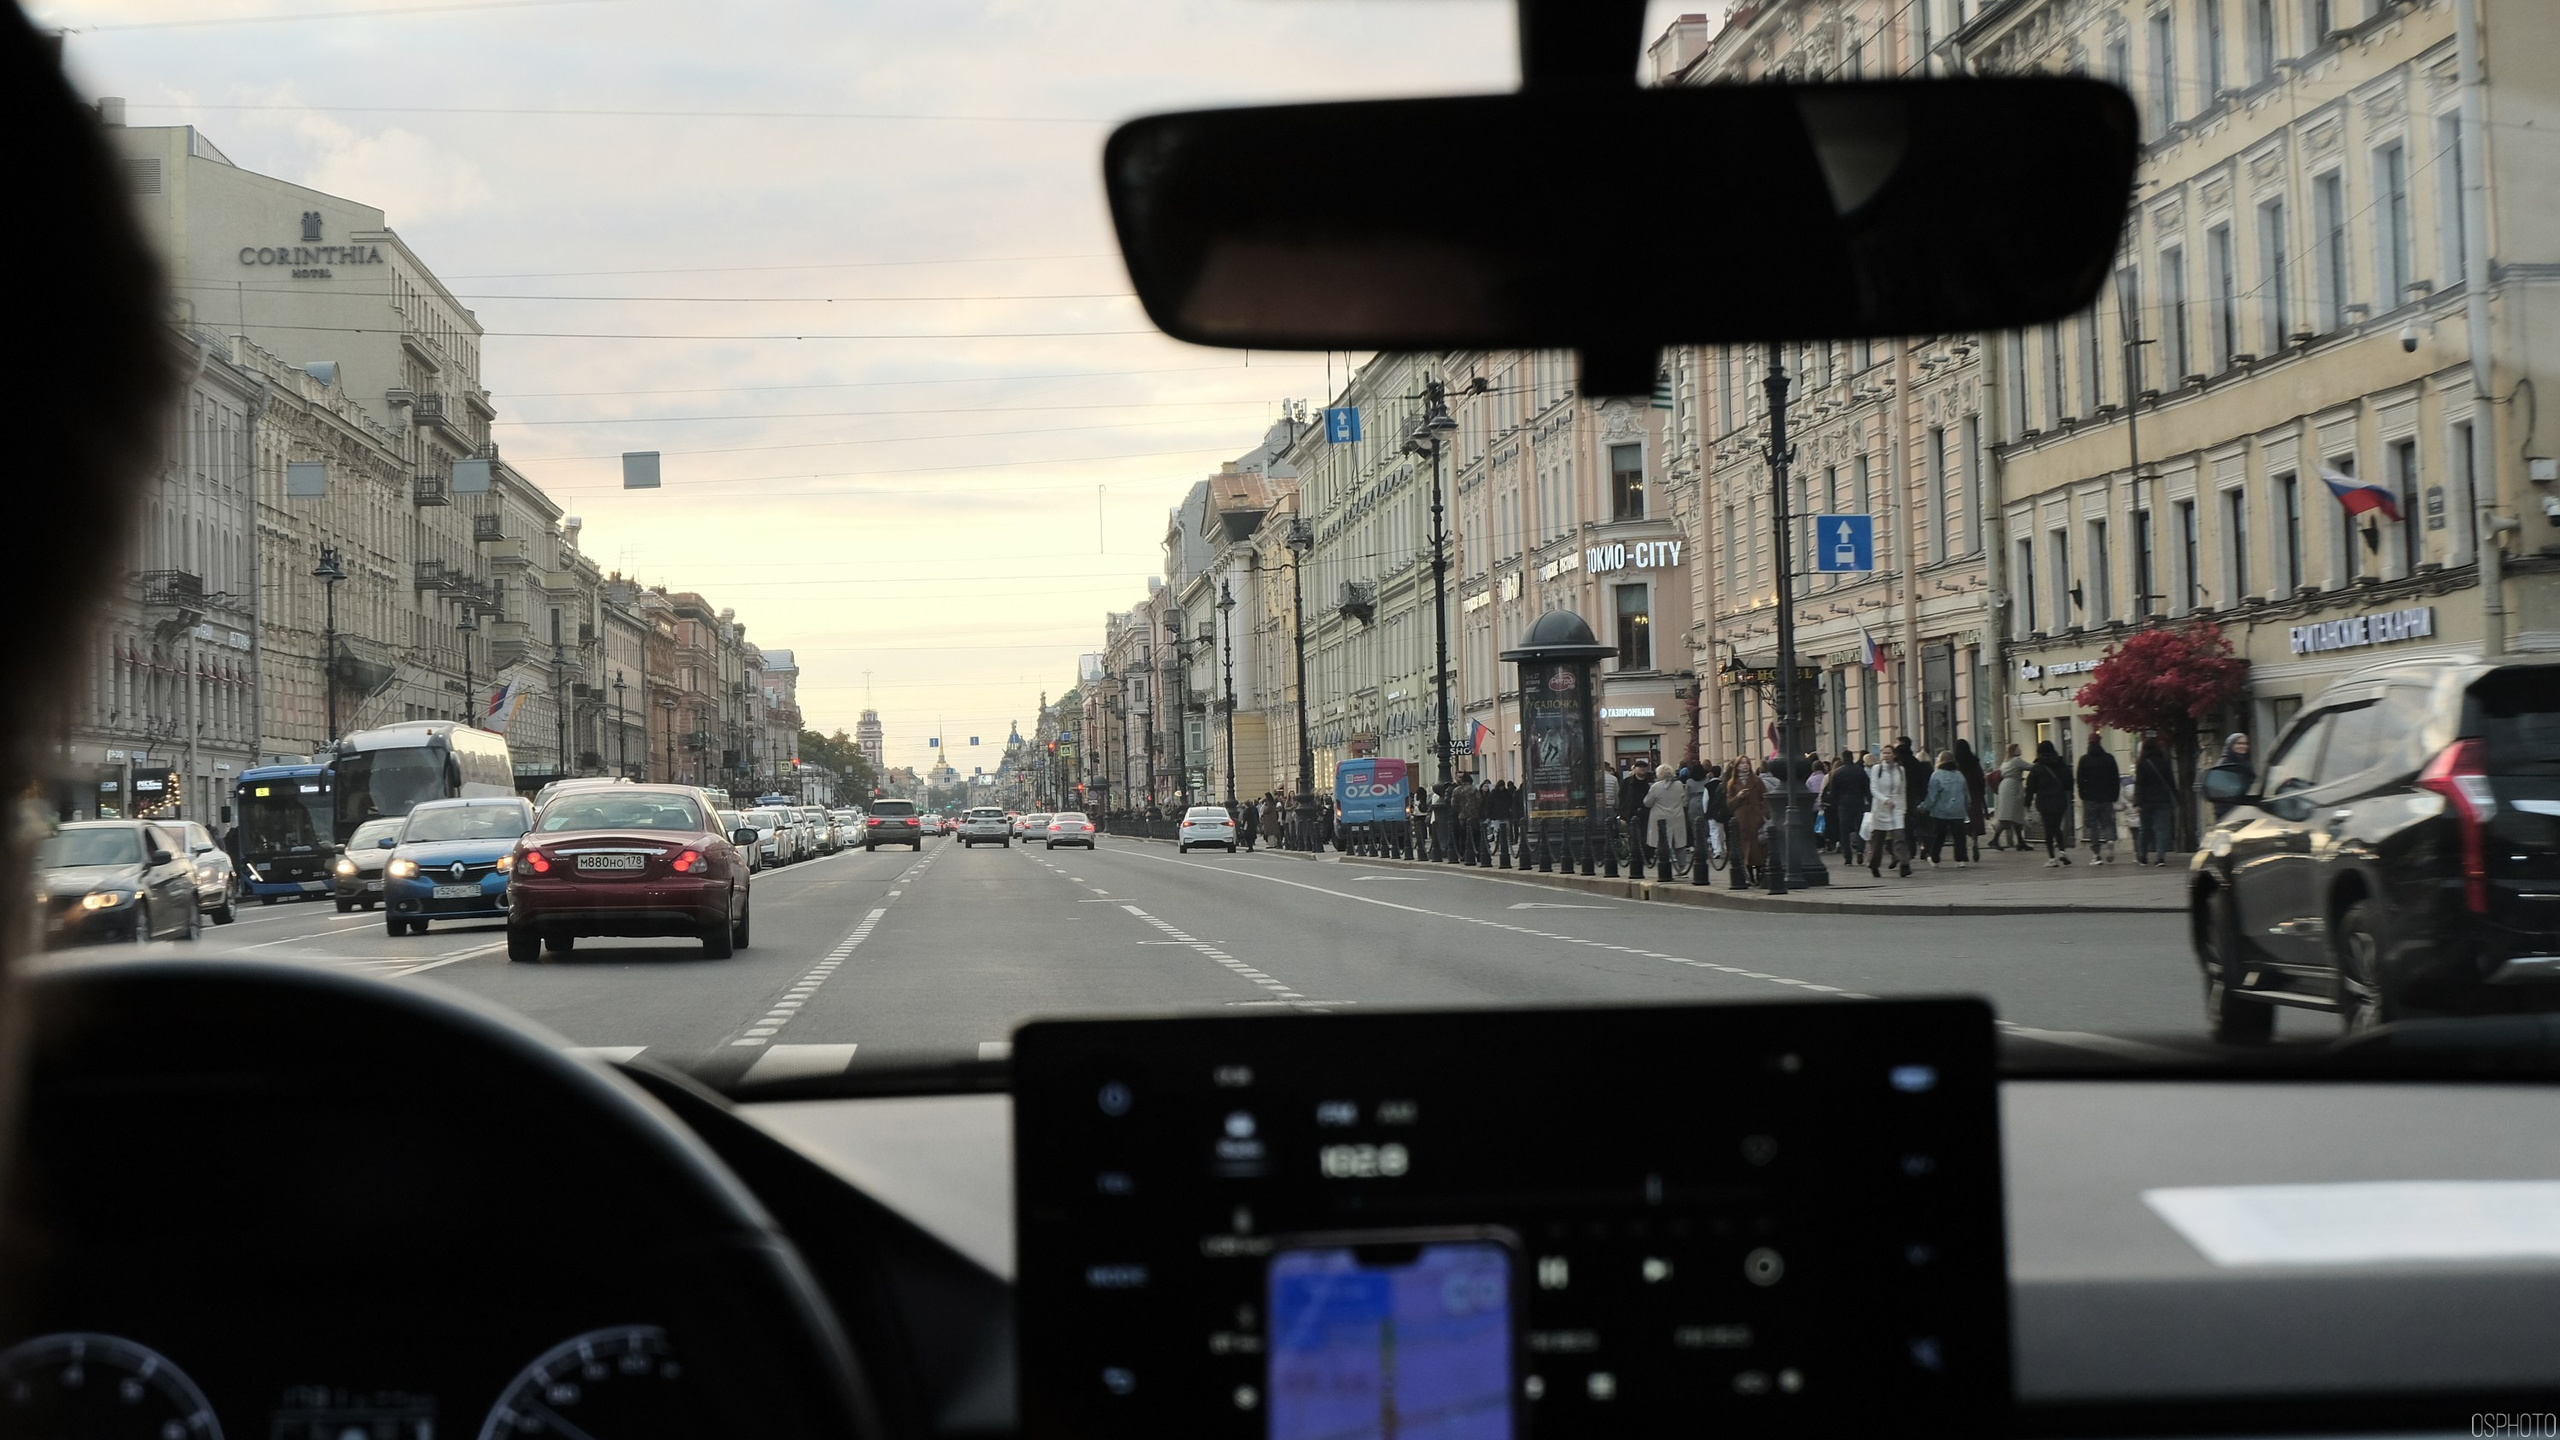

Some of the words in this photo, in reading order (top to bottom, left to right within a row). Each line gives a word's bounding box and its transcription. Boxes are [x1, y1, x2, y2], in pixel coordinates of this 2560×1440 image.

[238, 246, 384, 266] CORINTHIA
[291, 268, 332, 279] HOTEL
[1757, 668, 1813, 681] HOL
[1608, 707, 1655, 718] ГАЗПРОМБАНК
[1345, 783, 1400, 798] OZON
[626, 856, 642, 865] 178
